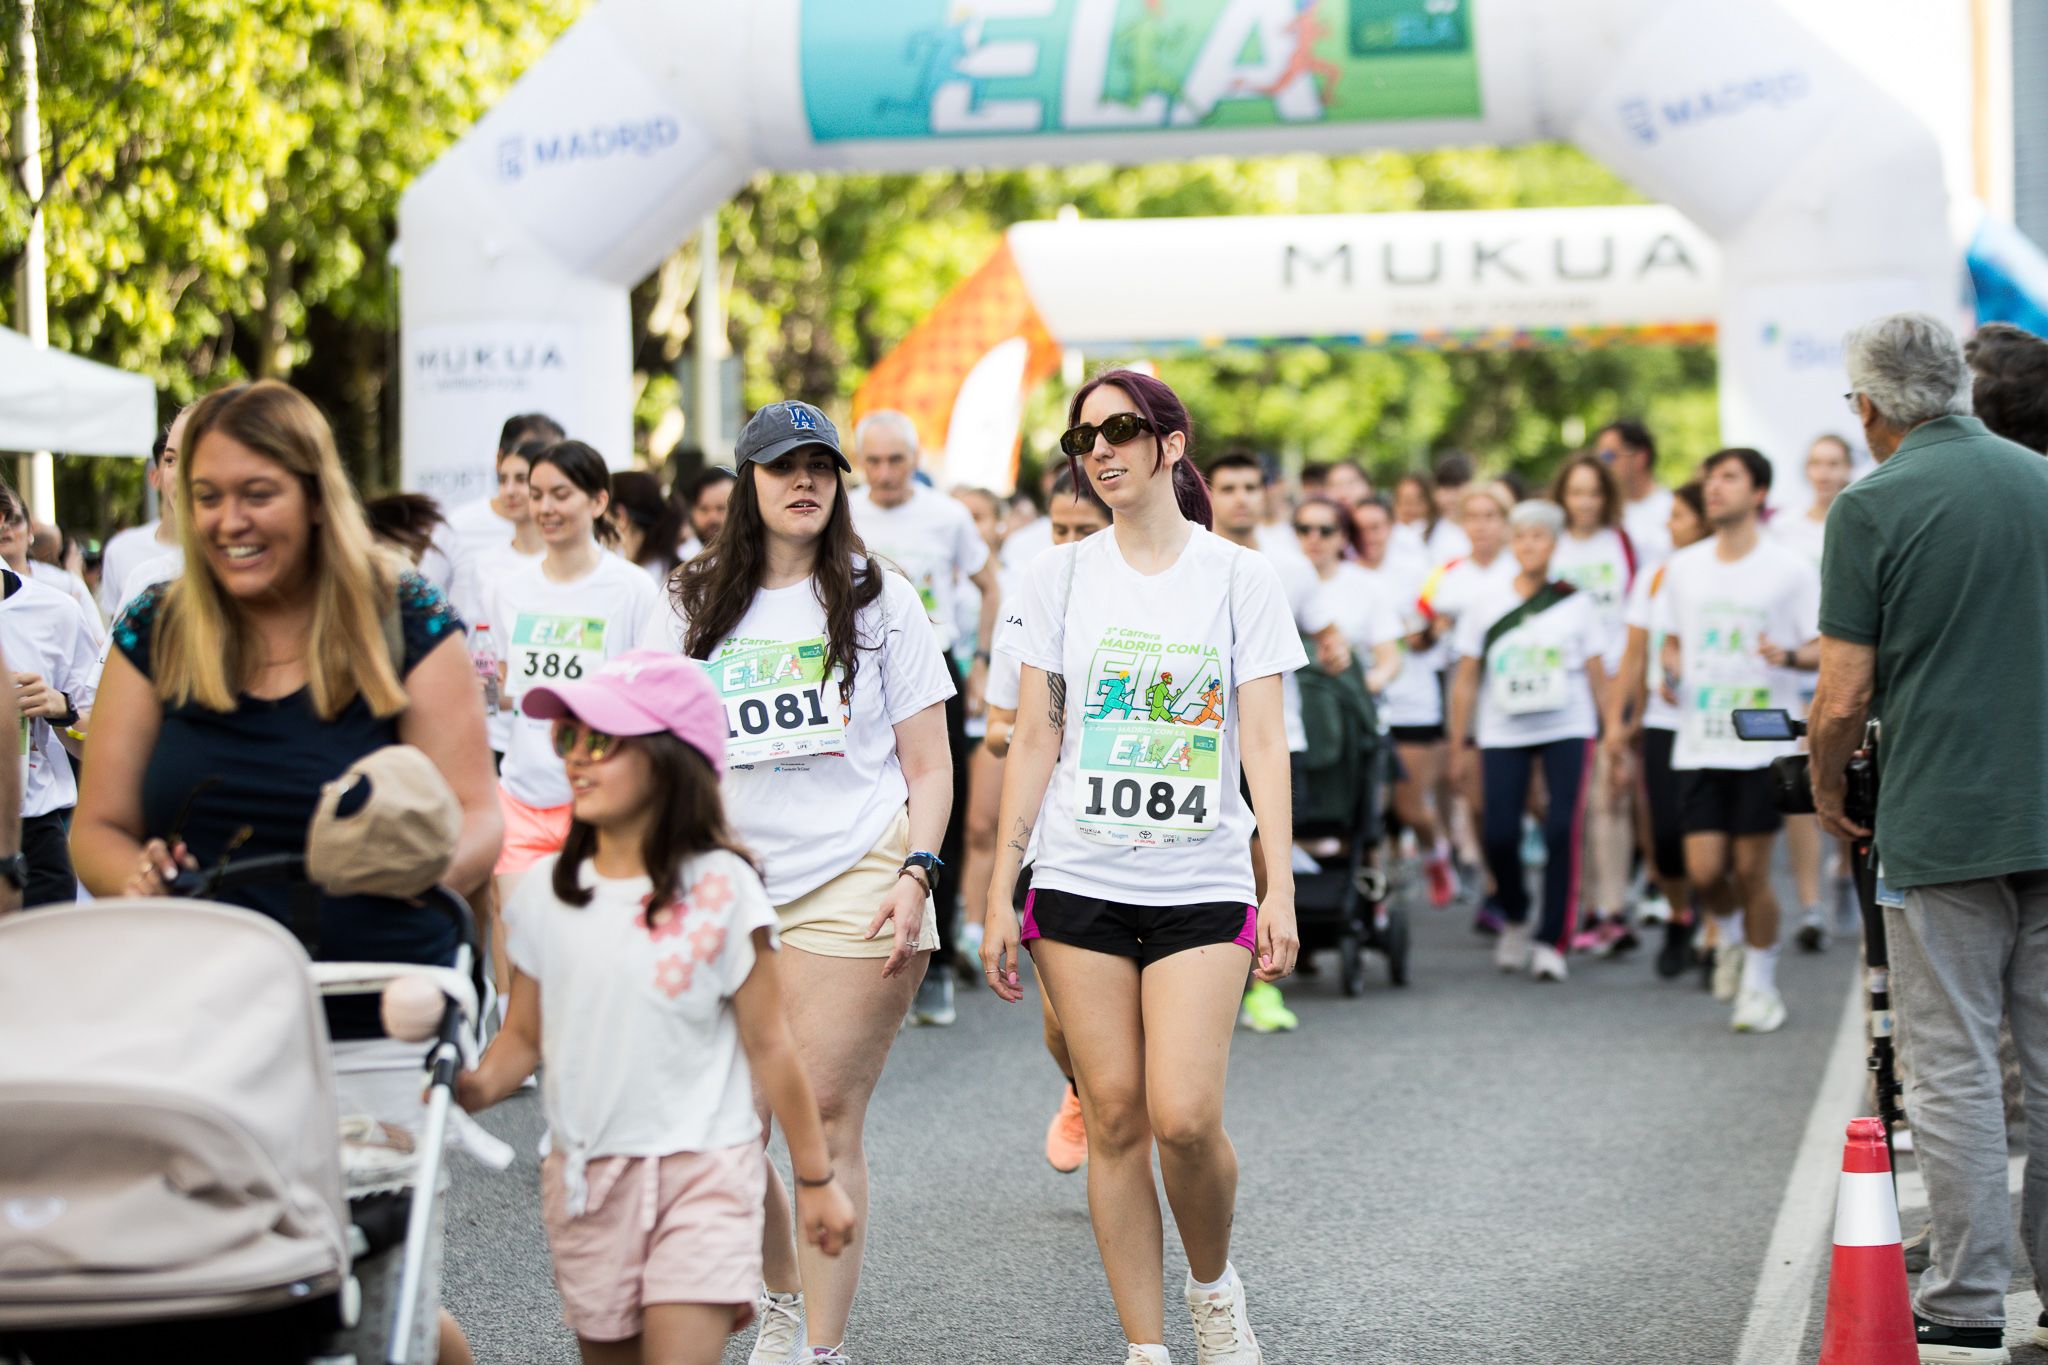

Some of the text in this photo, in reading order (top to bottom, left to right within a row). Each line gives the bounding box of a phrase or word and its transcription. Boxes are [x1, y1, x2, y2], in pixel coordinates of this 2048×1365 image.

[930, 0, 1325, 133] ELA
[1282, 233, 1699, 288] MUKUA
[417, 344, 567, 372] MUKUA
[786, 406, 817, 430] LA
[1100, 638, 1219, 657] MADRID CON LA
[1119, 628, 1161, 641] Carrera
[524, 652, 583, 679] 386
[722, 653, 803, 693] ELA
[1118, 726, 1153, 735] MADRID
[1154, 729, 1173, 737] CON
[1106, 734, 1191, 772] ELA
[1085, 777, 1208, 824] 1084
